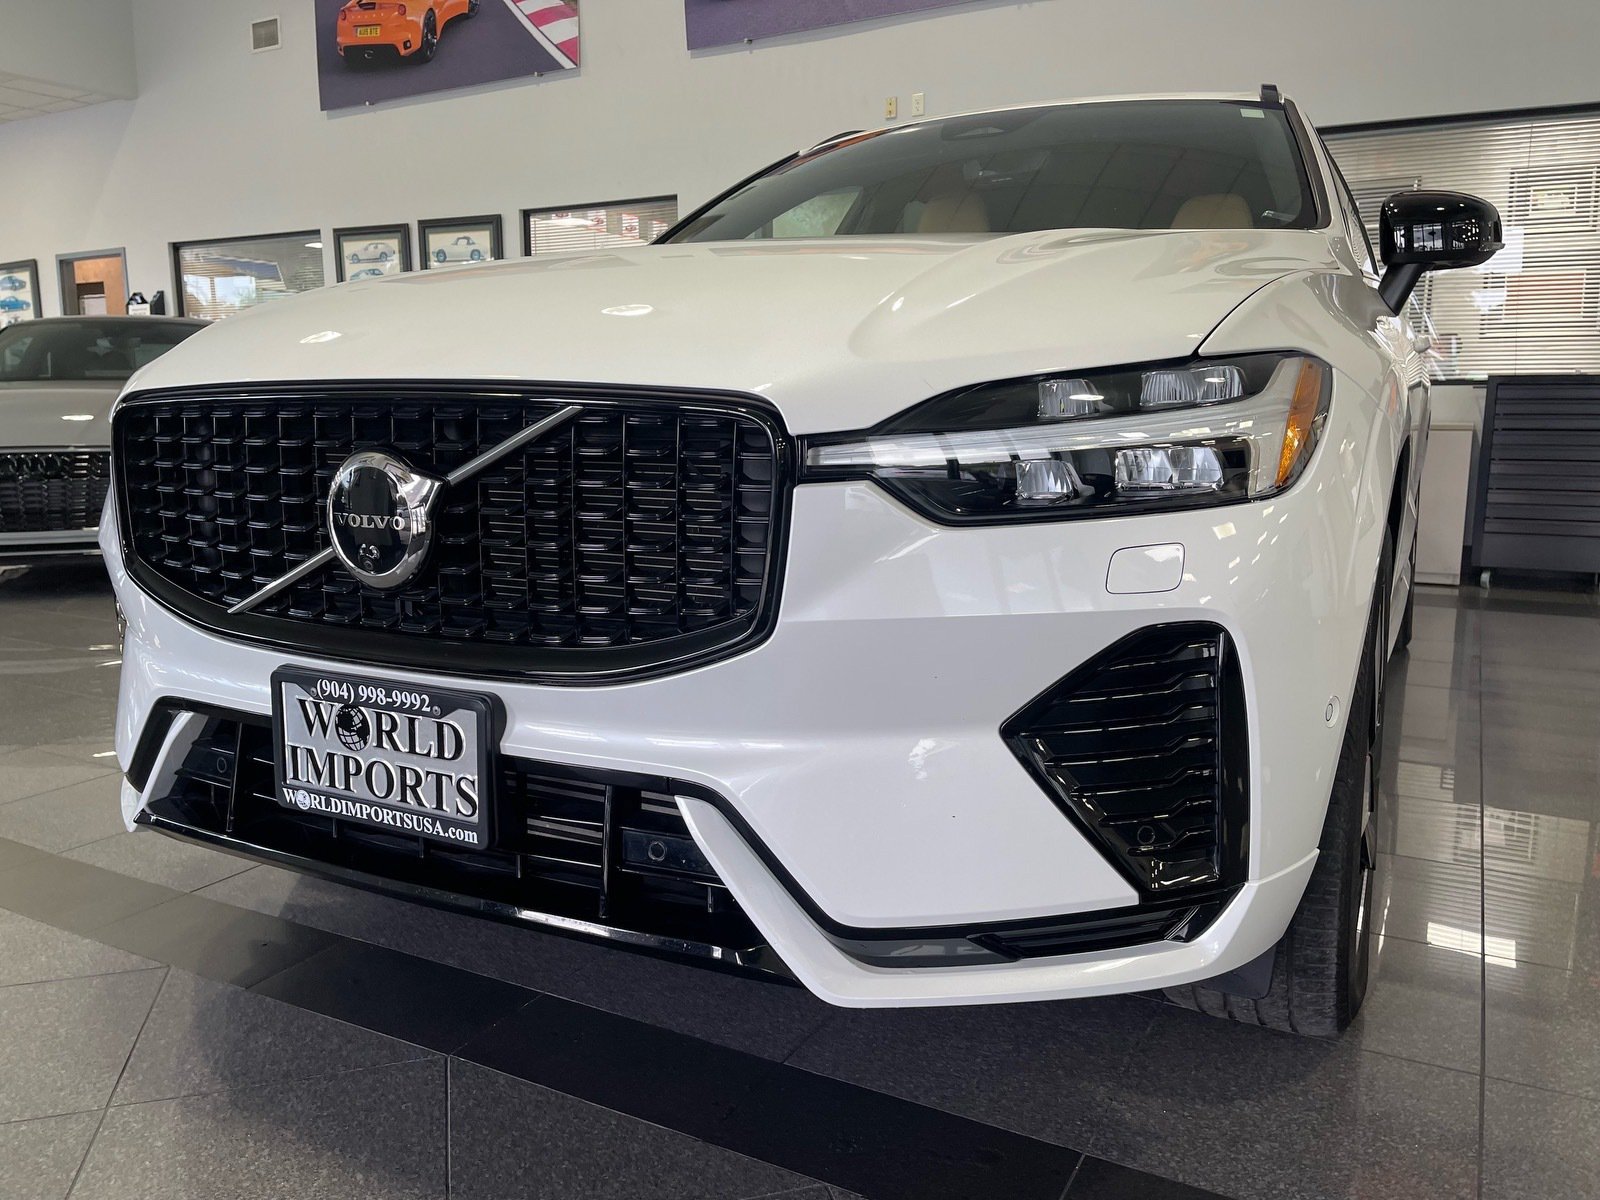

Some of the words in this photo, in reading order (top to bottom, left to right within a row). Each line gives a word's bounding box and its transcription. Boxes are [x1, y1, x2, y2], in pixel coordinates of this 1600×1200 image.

[334, 513, 405, 530] VOLVO
[317, 679, 355, 704] (904)
[359, 685, 431, 712] 998-9992
[297, 698, 464, 761] WORLD
[286, 745, 478, 817] IMPORTS
